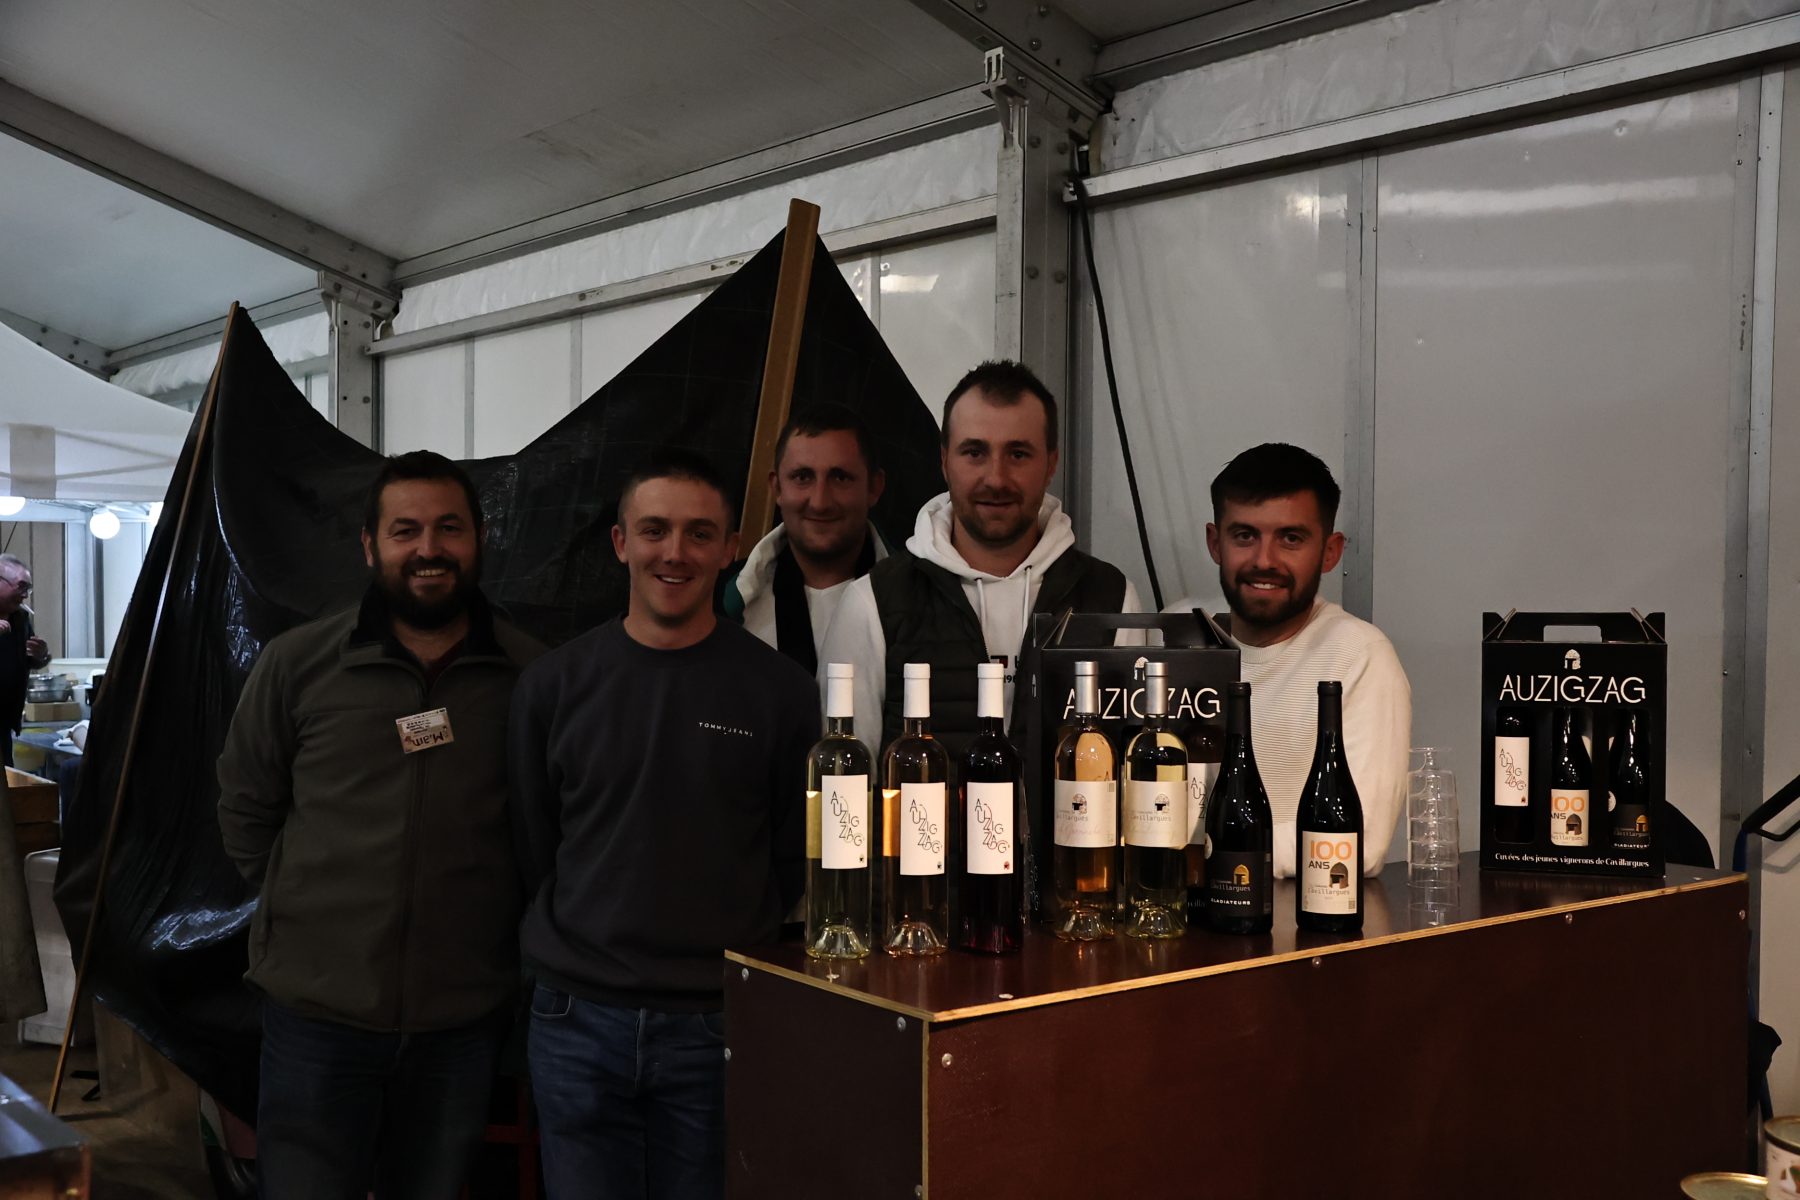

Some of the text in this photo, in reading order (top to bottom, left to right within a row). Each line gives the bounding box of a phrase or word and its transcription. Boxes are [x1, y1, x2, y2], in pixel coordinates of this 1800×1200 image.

[1499, 674, 1647, 704] AUZIGZAG
[698, 722, 727, 731] TOMMY
[1553, 796, 1585, 812] 00
[1310, 840, 1353, 861] 100
[1308, 860, 1331, 870] ANS
[1495, 852, 1650, 868] Cuvées des jeunes vignerons de Cavillargues
